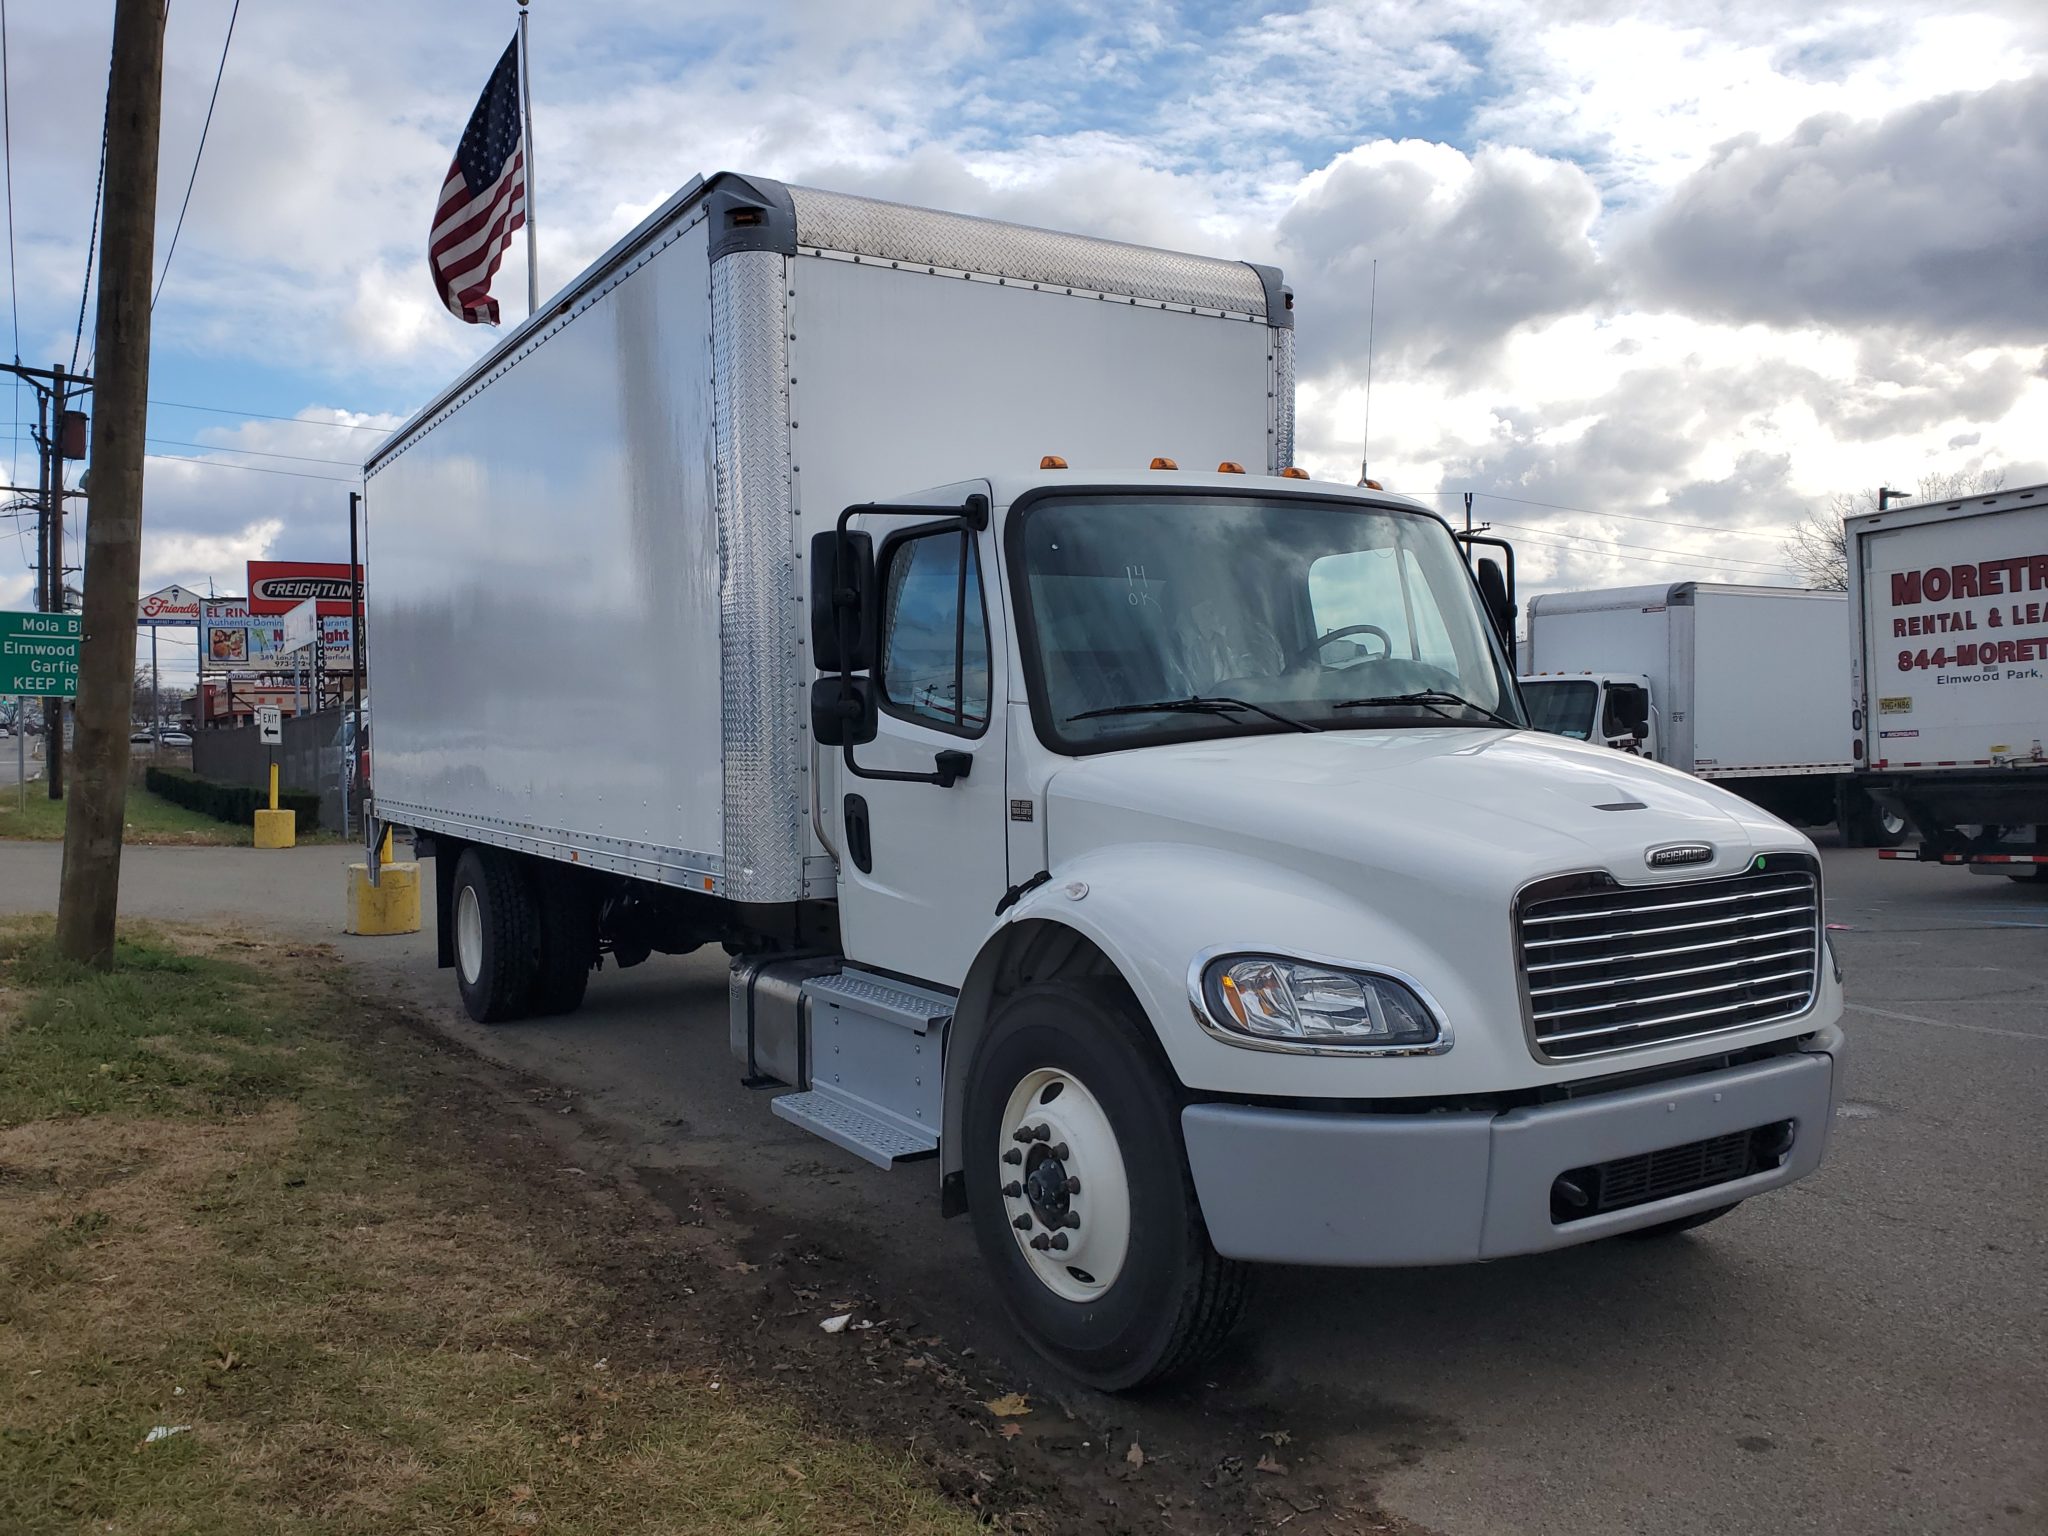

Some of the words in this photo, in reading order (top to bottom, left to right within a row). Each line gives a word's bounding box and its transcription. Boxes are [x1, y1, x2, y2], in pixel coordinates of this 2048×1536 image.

[206, 608, 220, 618] EL
[22, 618, 59, 632] Mola
[1893, 610, 1977, 638] RENTAL
[1988, 607, 2003, 628] &
[4, 641, 75, 656] Elmwood
[317, 620, 325, 667] TRUCK
[14, 677, 56, 690] KEEP
[1937, 672, 2000, 685] Elmwood
[2007, 668, 2043, 680] Park,
[263, 713, 278, 724] EXIT
[1656, 848, 1709, 864] FREIGHTLINER
